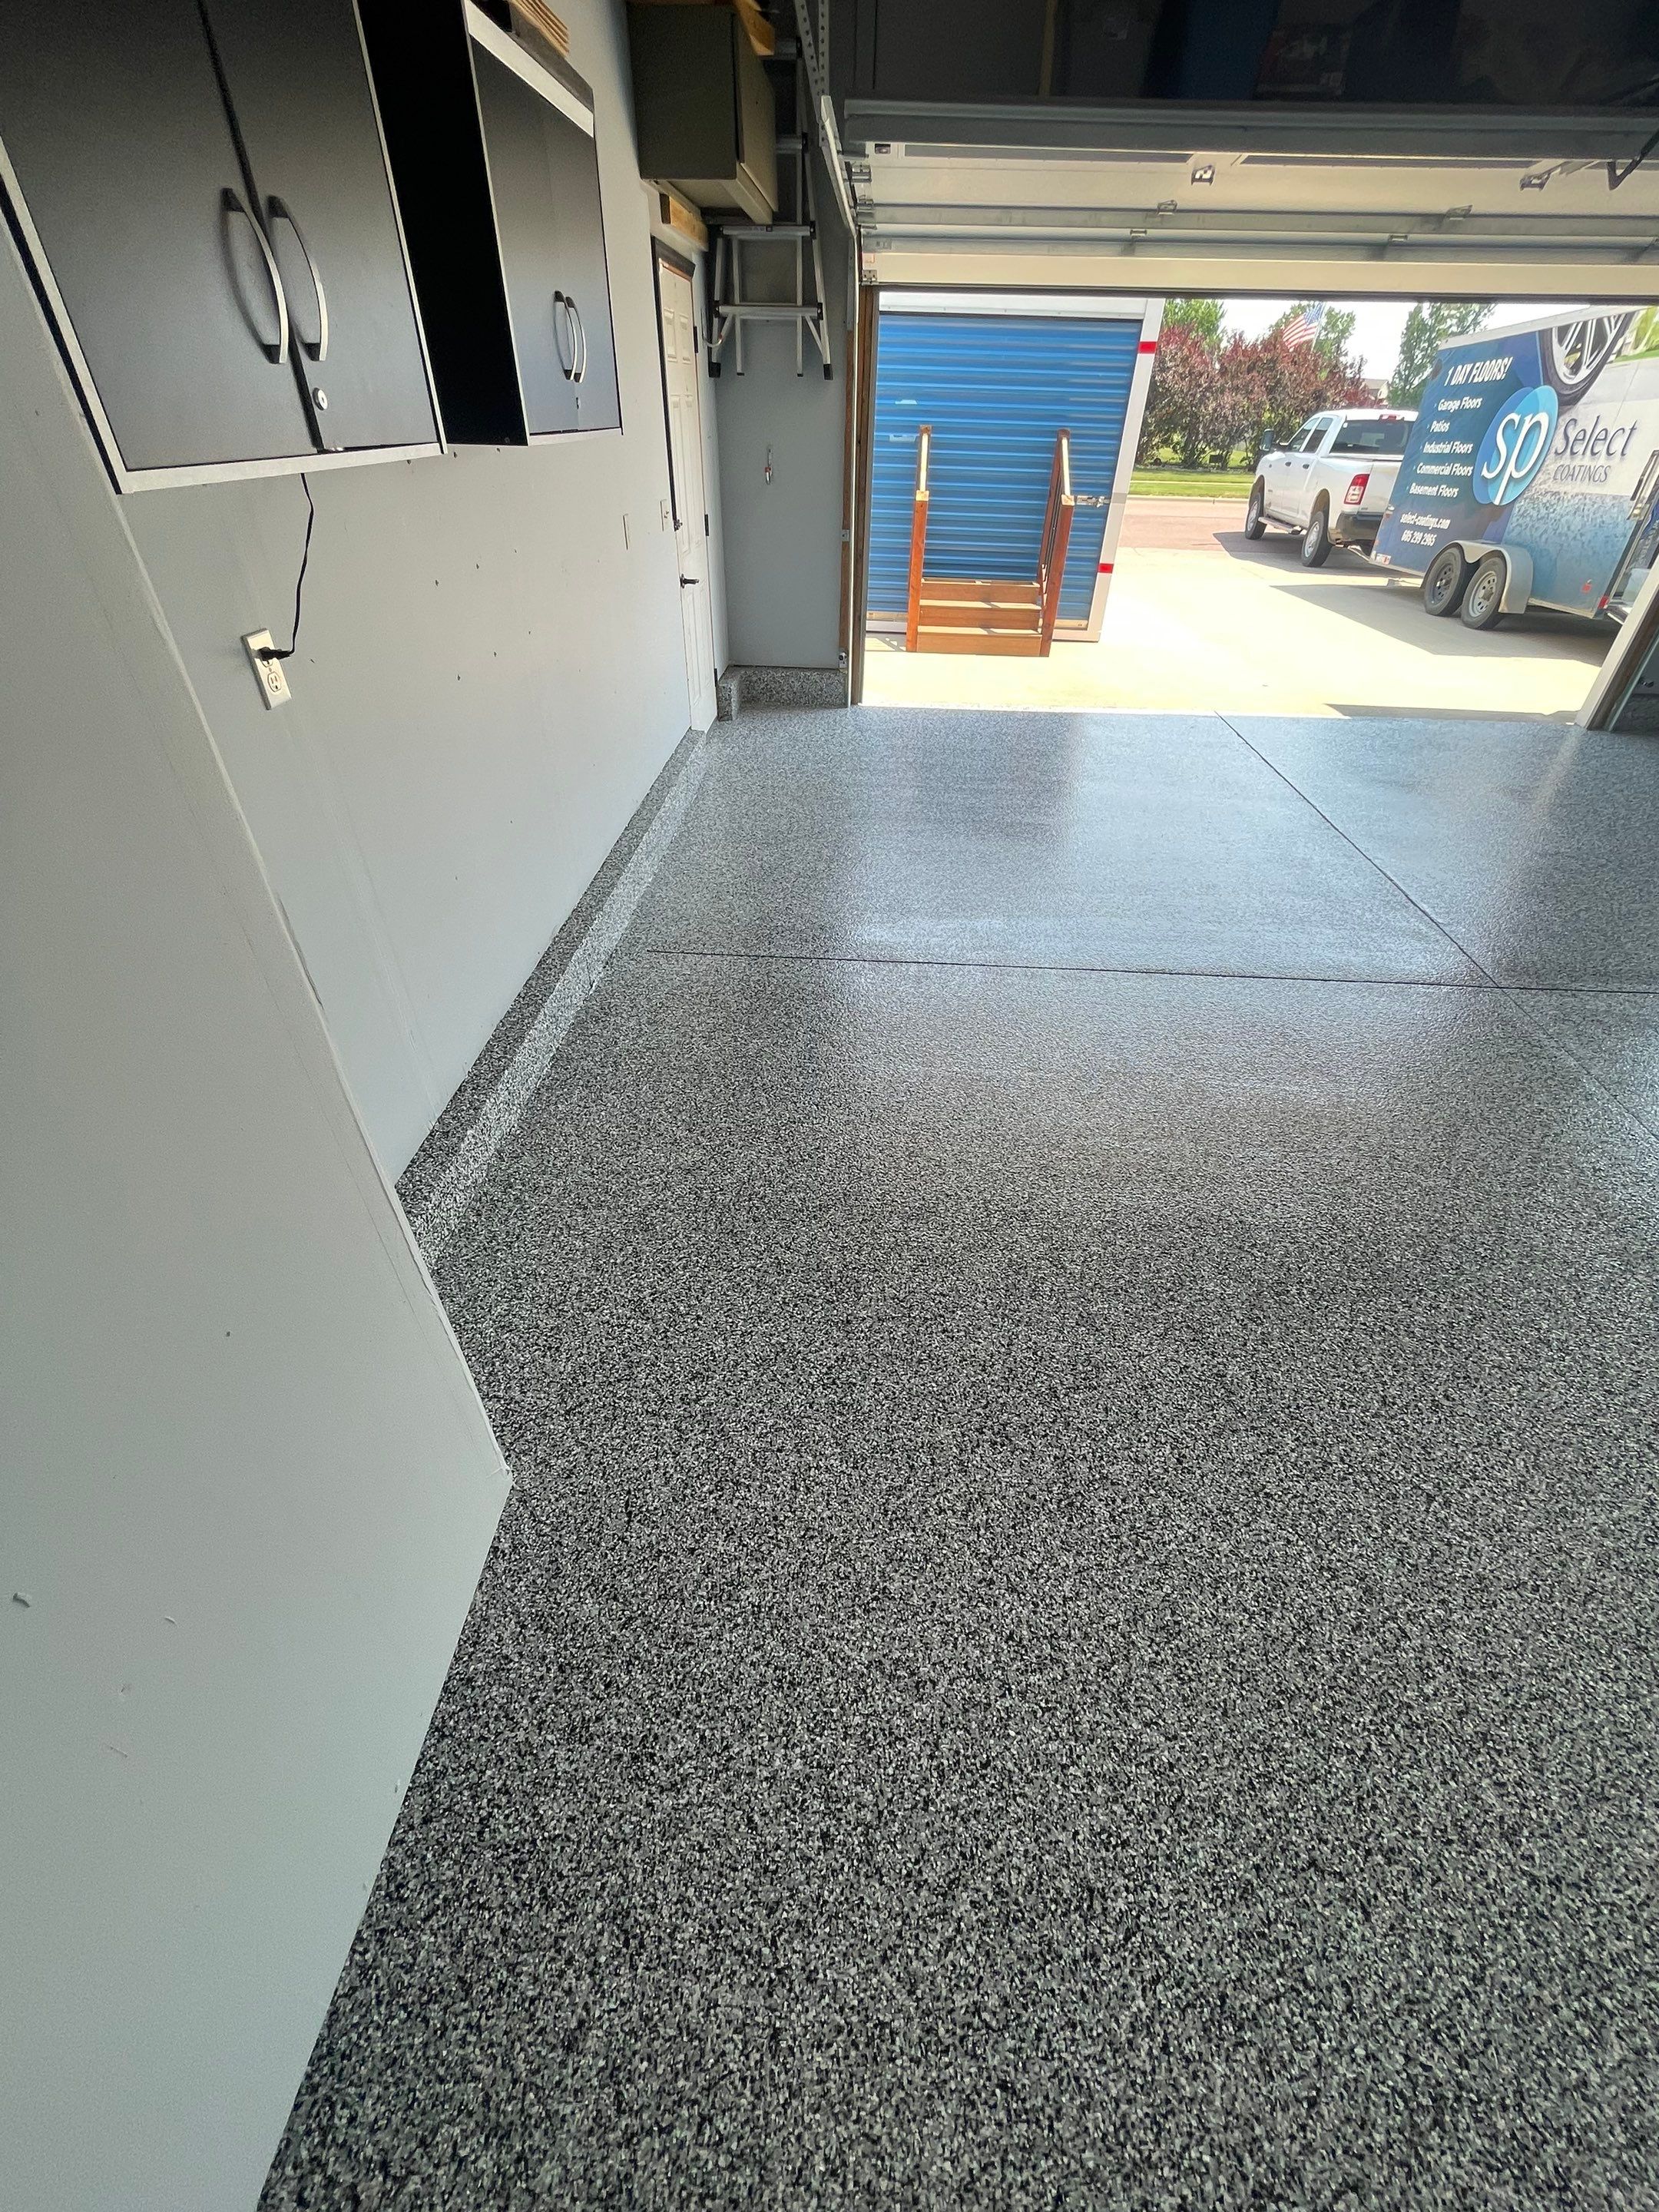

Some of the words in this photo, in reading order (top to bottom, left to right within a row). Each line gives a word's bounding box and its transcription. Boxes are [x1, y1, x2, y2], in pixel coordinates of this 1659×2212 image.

[1444, 366, 1454, 386] 1
[1450, 363, 1474, 386] DAY
[1468, 356, 1514, 383] FLOORS!
[1438, 399, 1461, 412] Garage
[1460, 396, 1483, 409] Floors
[1429, 419, 1451, 432] Patios
[1554, 415, 1638, 457] Select
[1422, 441, 1453, 454] Industrial
[1451, 441, 1474, 455] Floors
[1416, 462, 1453, 475] Commercial
[1451, 462, 1474, 477] Floors
[1553, 464, 1611, 483] COATINGS
[1409, 482, 1439, 496] Basement
[1437, 485, 1459, 498] Floors
[1399, 512, 1451, 530] select-coatings.com
